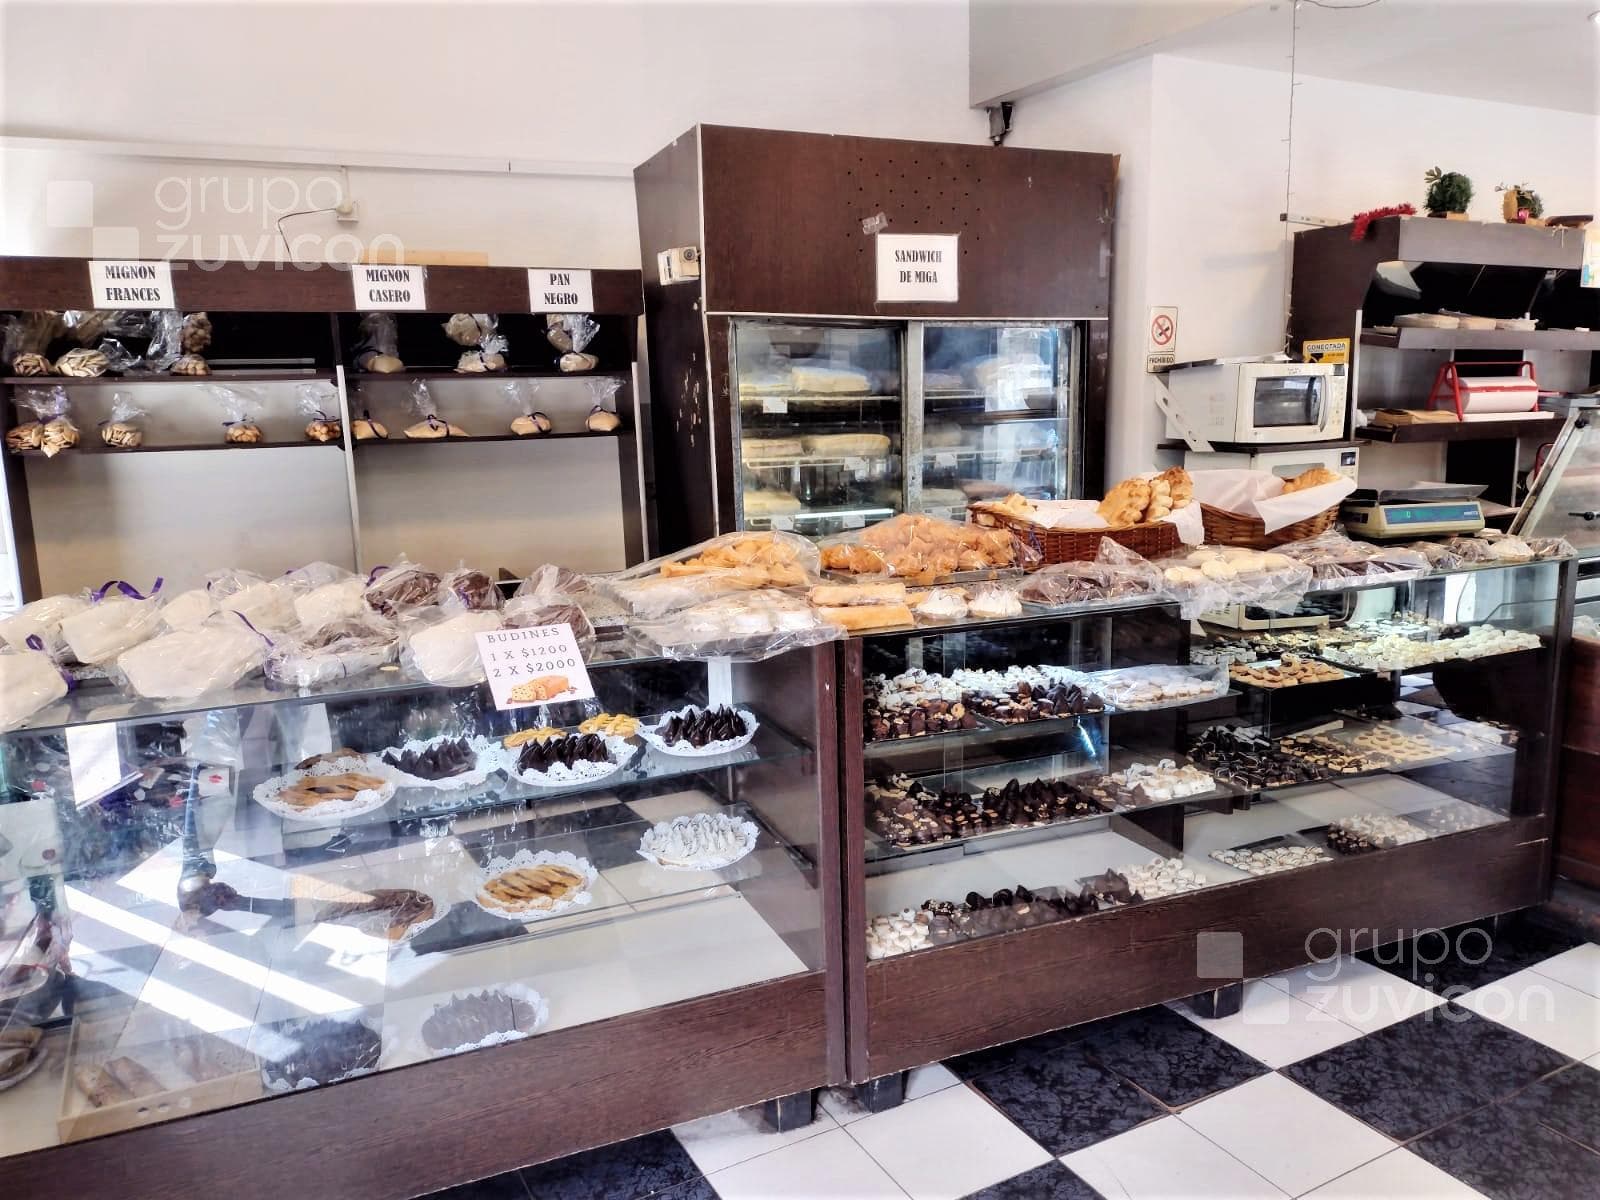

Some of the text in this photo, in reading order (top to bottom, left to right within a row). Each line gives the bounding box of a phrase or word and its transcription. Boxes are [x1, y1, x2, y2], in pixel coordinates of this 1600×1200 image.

[895, 249, 942, 263] SANDWICH
[105, 264, 156, 281] MIGNON
[366, 269, 410, 283] MIGNON
[550, 272, 571, 287] PAN
[899, 270, 938, 283] DE MIGA
[106, 286, 161, 302] FRANCES
[369, 289, 411, 303] CASERO
[544, 292, 578, 305] NEGRO
[487, 627, 560, 643] BUDINES
[490, 652, 496, 661] 1
[521, 644, 567, 658] $1200
[493, 668, 501, 678] 2
[526, 658, 576, 674] $2000
